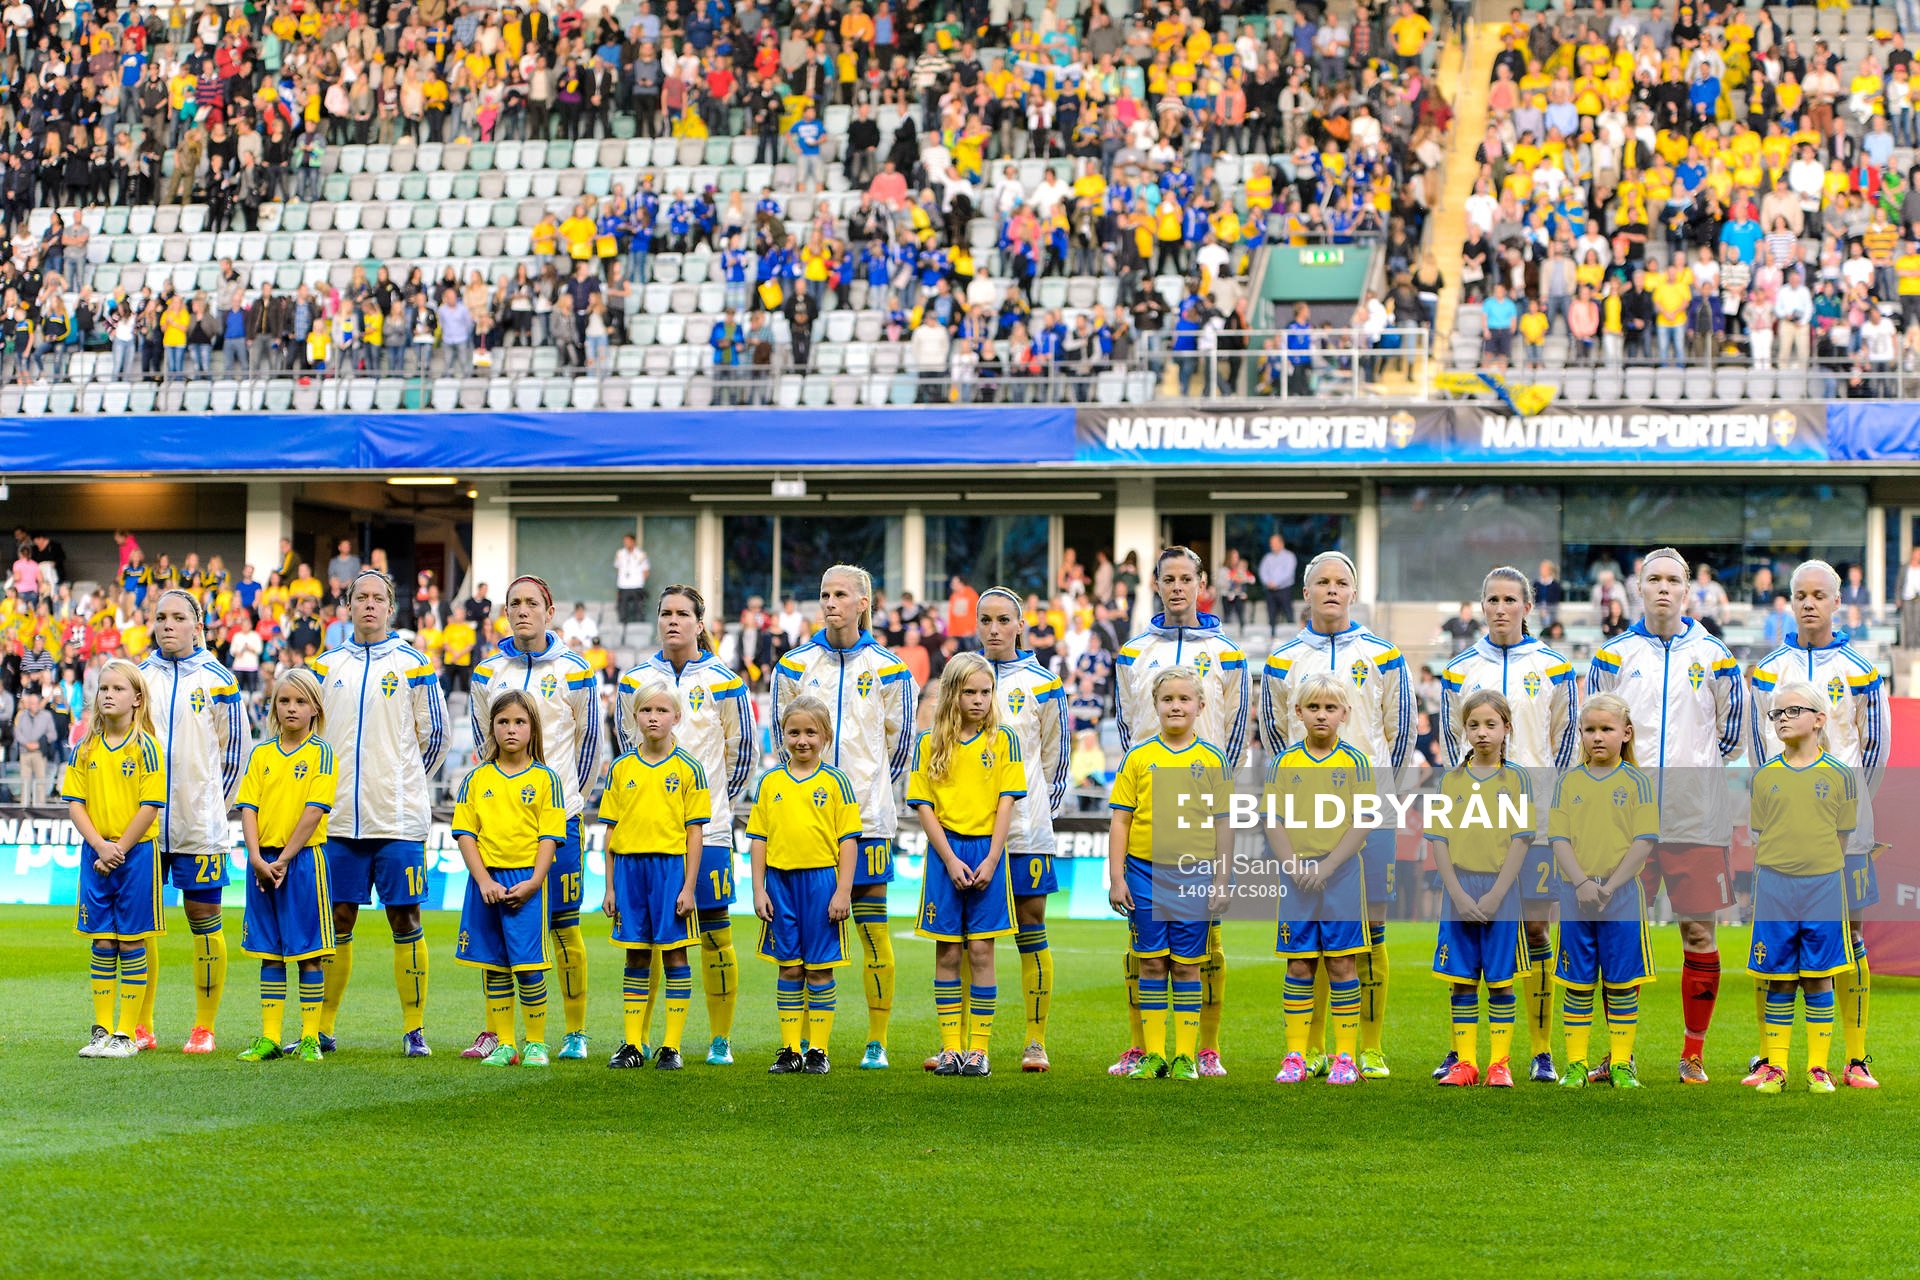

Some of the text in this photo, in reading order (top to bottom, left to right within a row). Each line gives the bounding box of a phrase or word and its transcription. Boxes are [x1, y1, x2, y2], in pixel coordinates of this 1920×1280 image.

[1105, 416, 1389, 449] NATIONALSPORTEN
[1481, 414, 1769, 448] NATIONALSPORTEN
[195, 854, 222, 883] 23
[865, 845, 886, 876] 10
[1029, 857, 1043, 888] 9
[404, 866, 423, 897] 16
[560, 873, 580, 903] 15
[709, 869, 731, 900] 14
[1537, 861, 1550, 893] 2
[1716, 873, 1728, 904] 1
